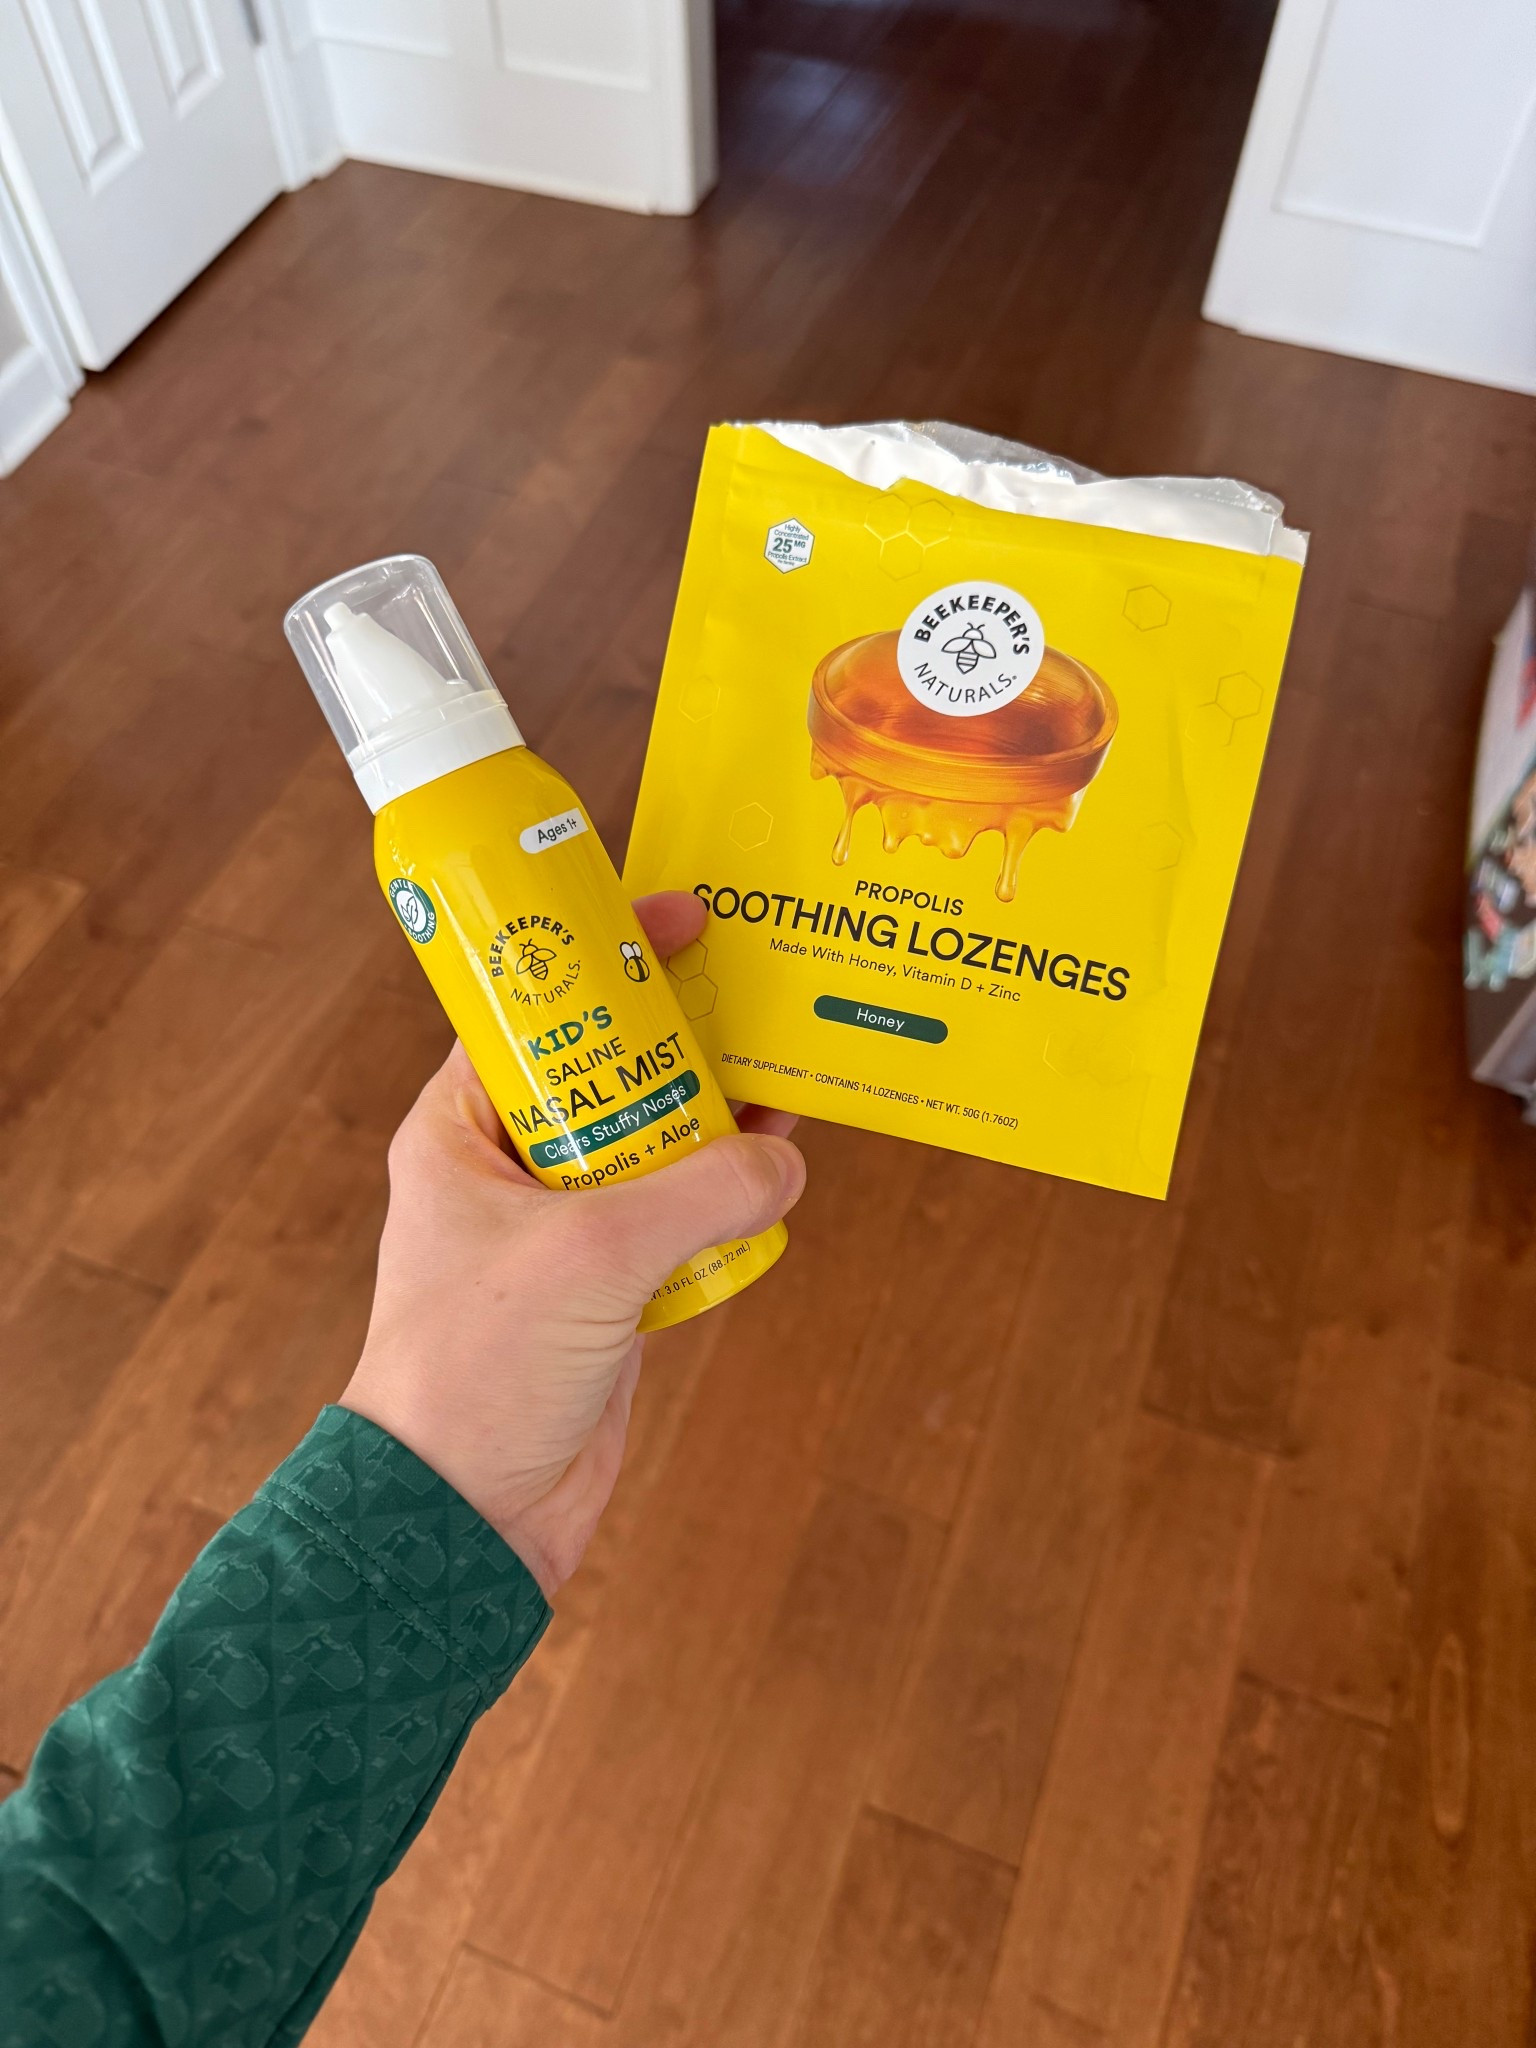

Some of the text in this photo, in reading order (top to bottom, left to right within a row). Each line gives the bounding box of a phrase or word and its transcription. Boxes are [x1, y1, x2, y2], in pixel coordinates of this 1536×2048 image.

[772, 538, 806, 553] 25 MG
[774, 529, 809, 540] Concentrated
[784, 524, 801, 532] Highly
[768, 551, 807, 563] Propolis Extract
[914, 594, 1030, 656] BEEKEEPER'S
[537, 818, 577, 843] Ages 1+
[854, 880, 964, 916] PROPOLIS
[490, 915, 575, 978] BEEKEEPER'S
[770, 938, 1021, 1002] Made With Honey, Vitamin D + Zinc
[908, 921, 1131, 1001] LOZENGES
[527, 1006, 612, 1060] KID'S
[856, 1008, 905, 1032] Honey
[509, 1032, 685, 1136] NASAL MIST
[546, 1036, 626, 1086] SALINE
[722, 1053, 1019, 1130] DIETARY SUPPLEMENT CONTAINS 14 LOZENGES NET WT. 50G (1.76OZ)
[544, 1084, 687, 1160] Clears Stuffy Noses
[561, 1116, 700, 1190] Propolis + Aloe
[664, 1282, 680, 1296] 3.0
[680, 1276, 694, 1289] FL
[694, 1268, 708, 1281] OZ
[708, 1252, 736, 1276] (88.72
[736, 1240, 751, 1257] mL)
